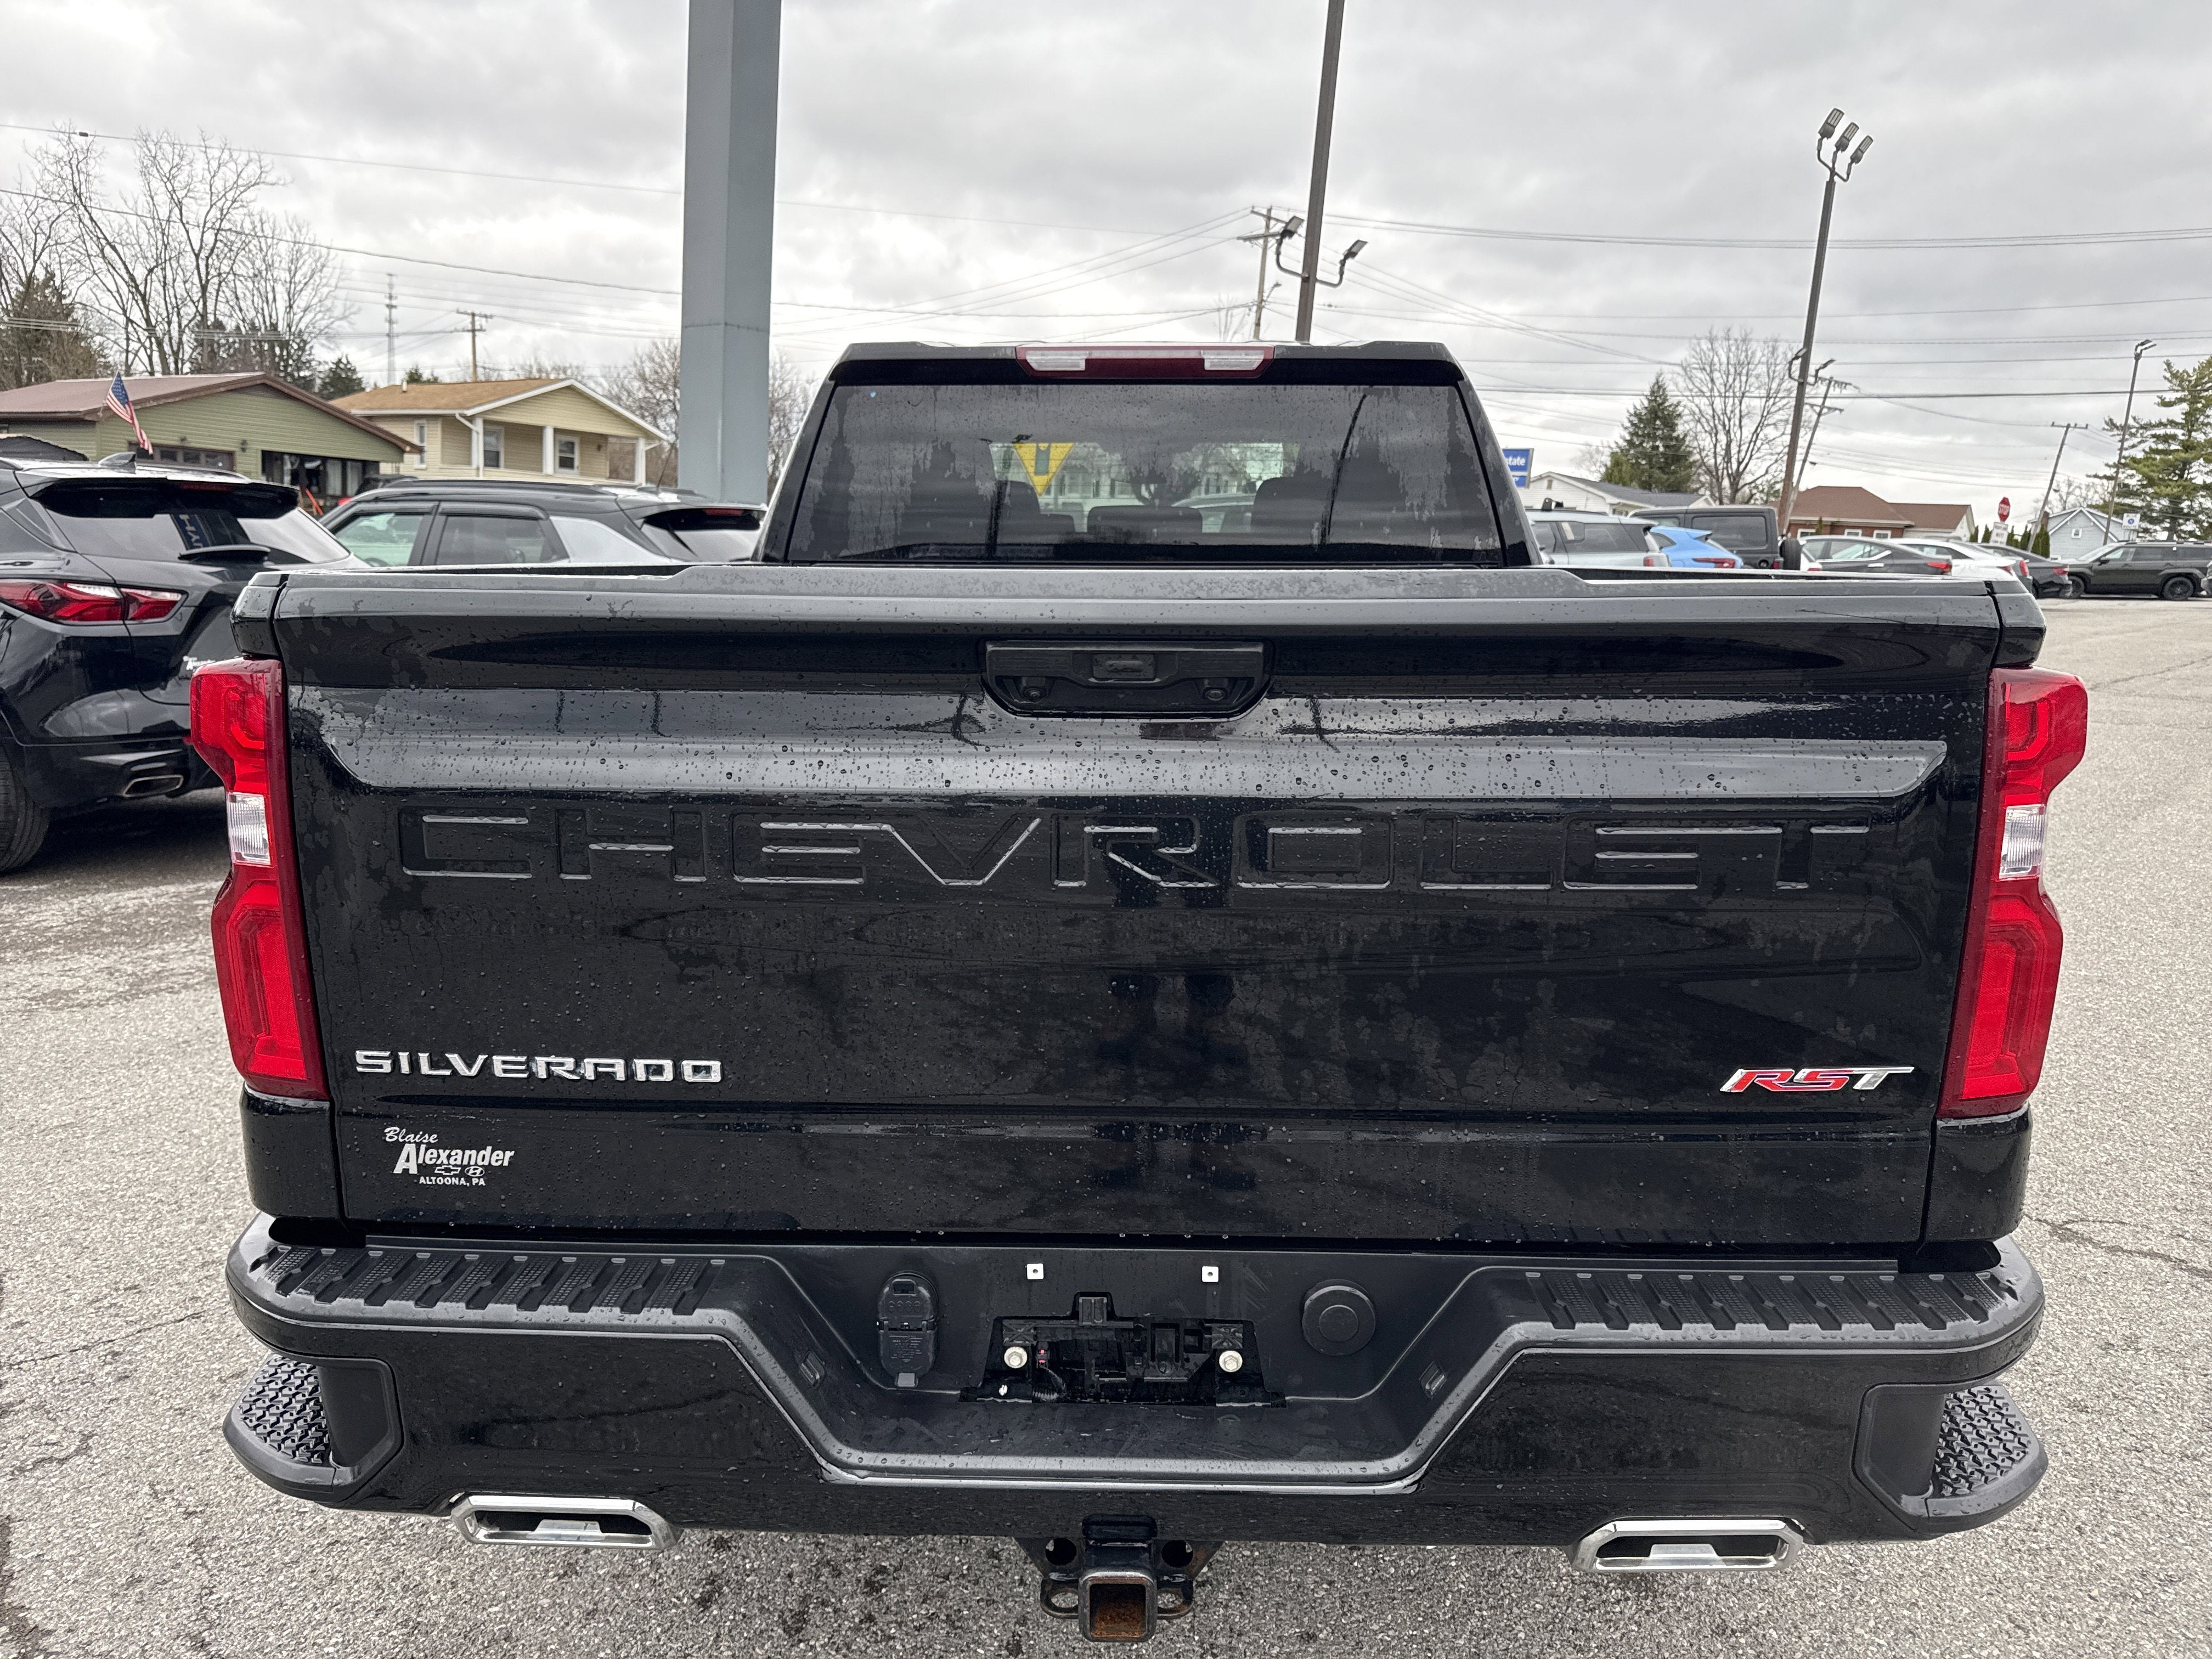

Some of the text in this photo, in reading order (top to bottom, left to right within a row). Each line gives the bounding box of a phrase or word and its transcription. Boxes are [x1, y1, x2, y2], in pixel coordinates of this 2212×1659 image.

[1999, 504, 2010, 515] STOP
[399, 806, 1870, 891] CHEVROLET
[356, 1049, 723, 1083] SILVERADO
[1719, 1066, 1915, 1092] RST
[384, 1126, 438, 1143] Blaise
[393, 1143, 515, 1174] Alexander
[419, 1176, 486, 1187] ALTOONA, PA
